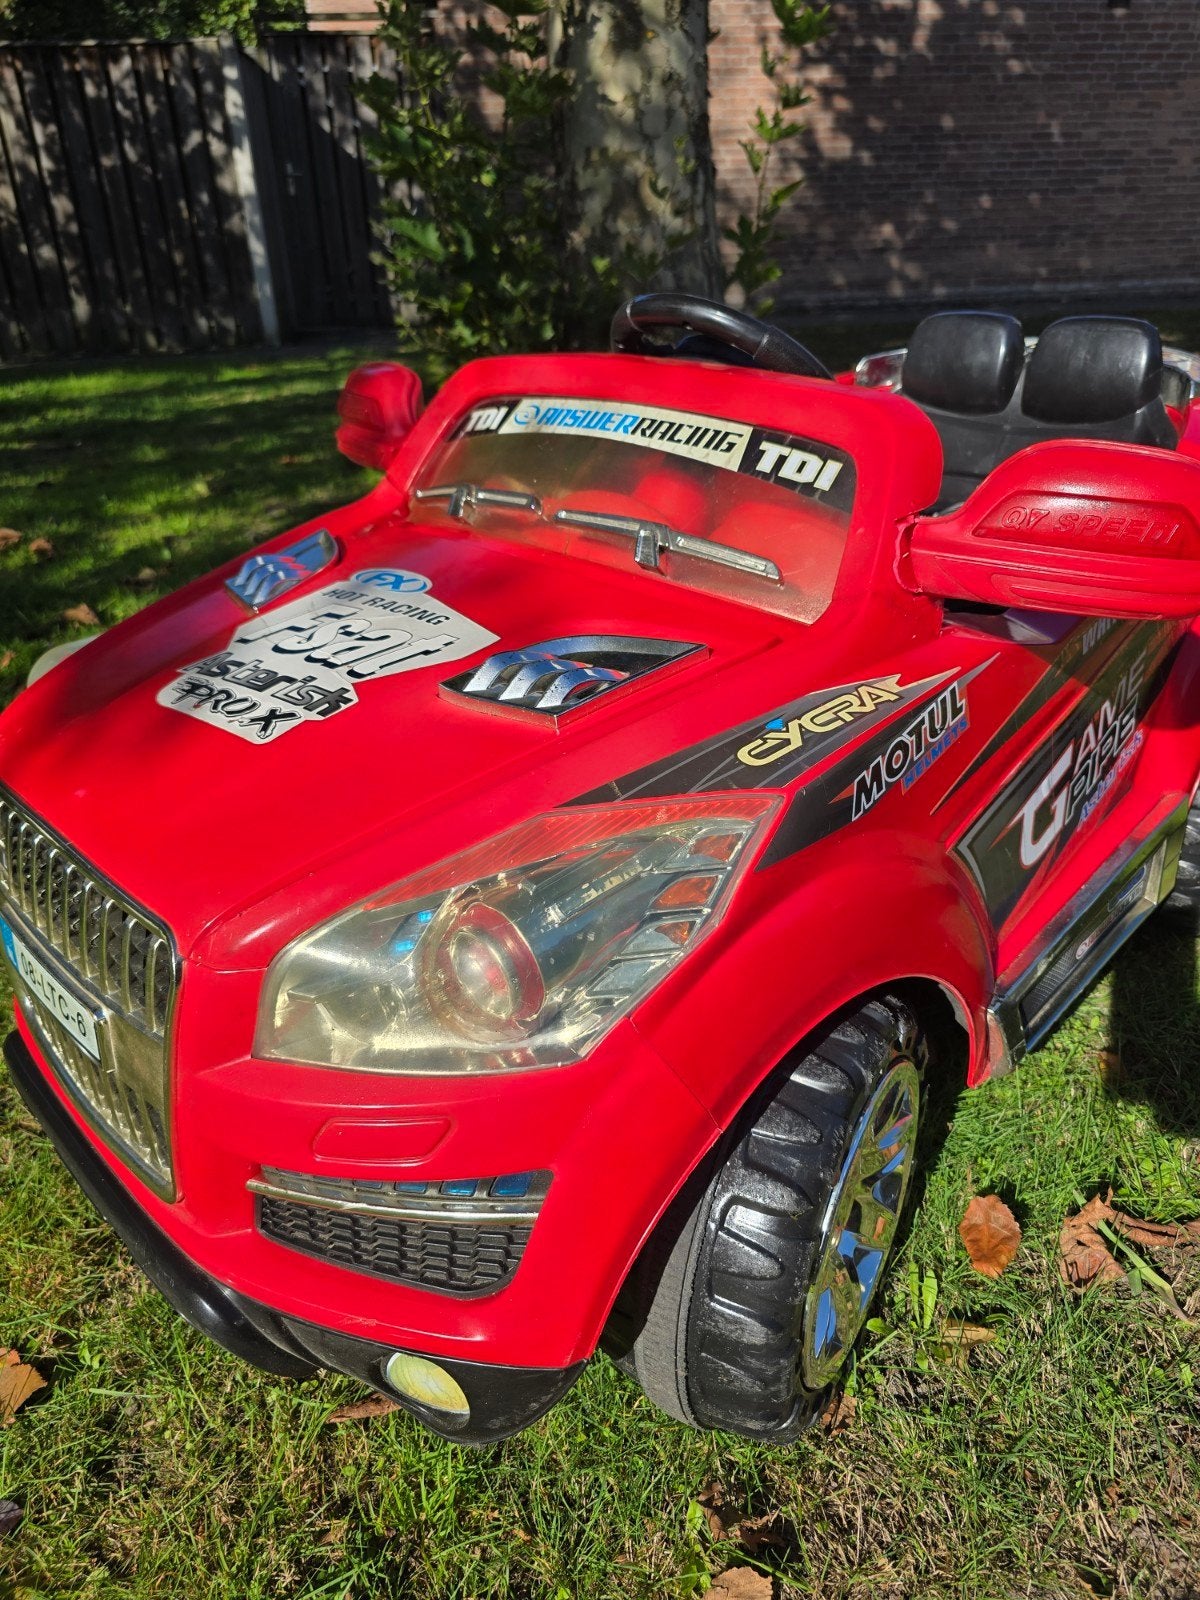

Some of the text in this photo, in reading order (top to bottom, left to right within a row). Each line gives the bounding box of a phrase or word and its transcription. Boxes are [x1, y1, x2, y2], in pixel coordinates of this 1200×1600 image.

[466, 406, 509, 432] TDI
[755, 441, 843, 491] TDI
[1057, 513, 1180, 543] SPEED
[321, 589, 451, 626] HOT RACING
[851, 681, 967, 822] MOTUL
[901, 716, 970, 793] HELMETS
[20, 951, 87, 1037] 08-LTC-6
